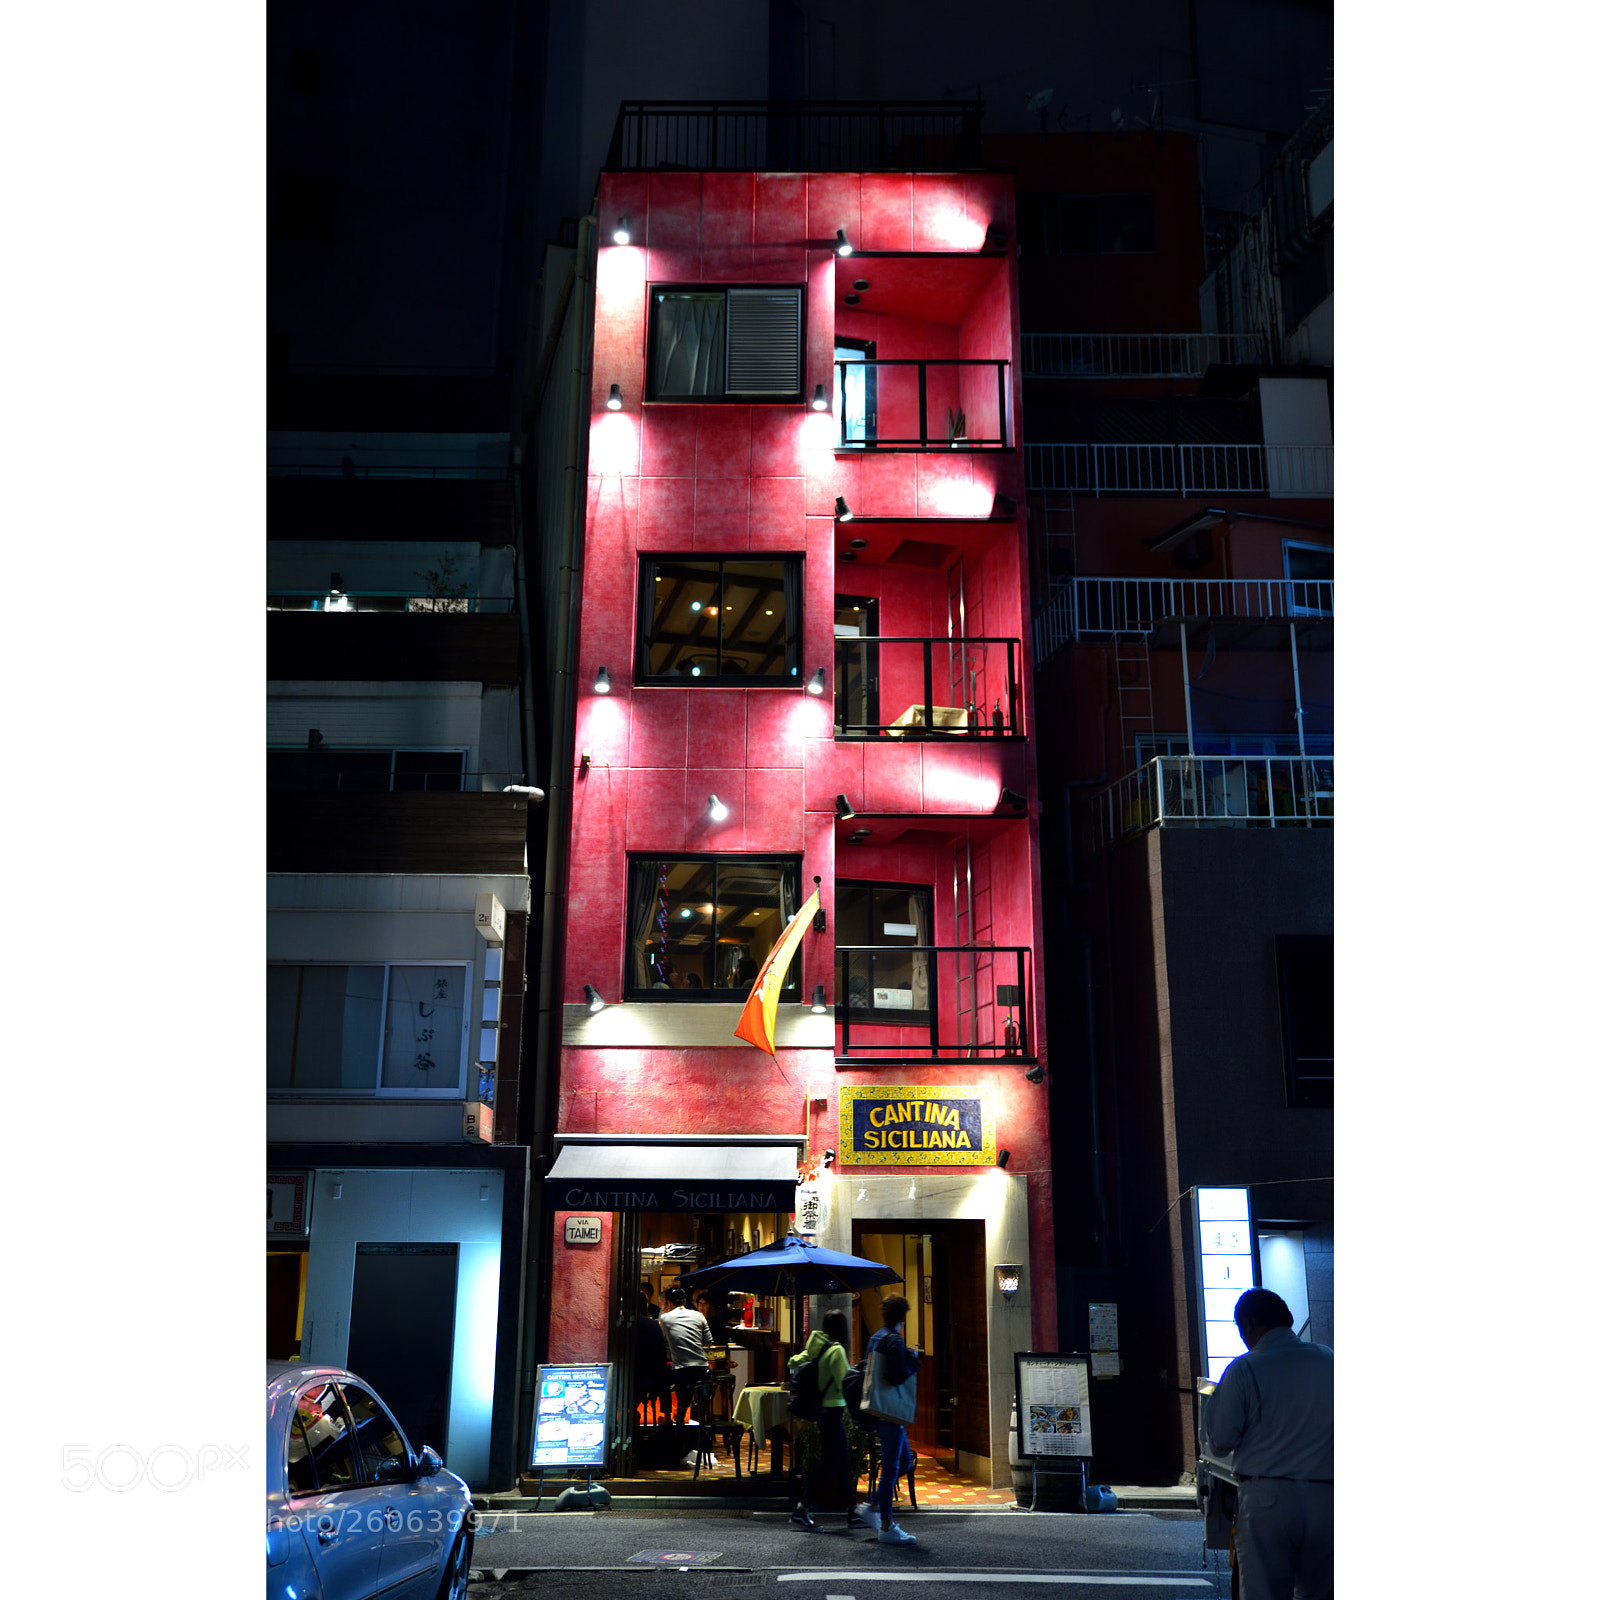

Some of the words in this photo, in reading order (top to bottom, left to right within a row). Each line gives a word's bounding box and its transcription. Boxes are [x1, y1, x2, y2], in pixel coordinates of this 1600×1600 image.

[413, 1001, 436, 1071] しぶ谷
[869, 1101, 961, 1131] CANTINA
[864, 1130, 972, 1149] SICILIANA
[568, 1228, 598, 1239] TAIMEI
